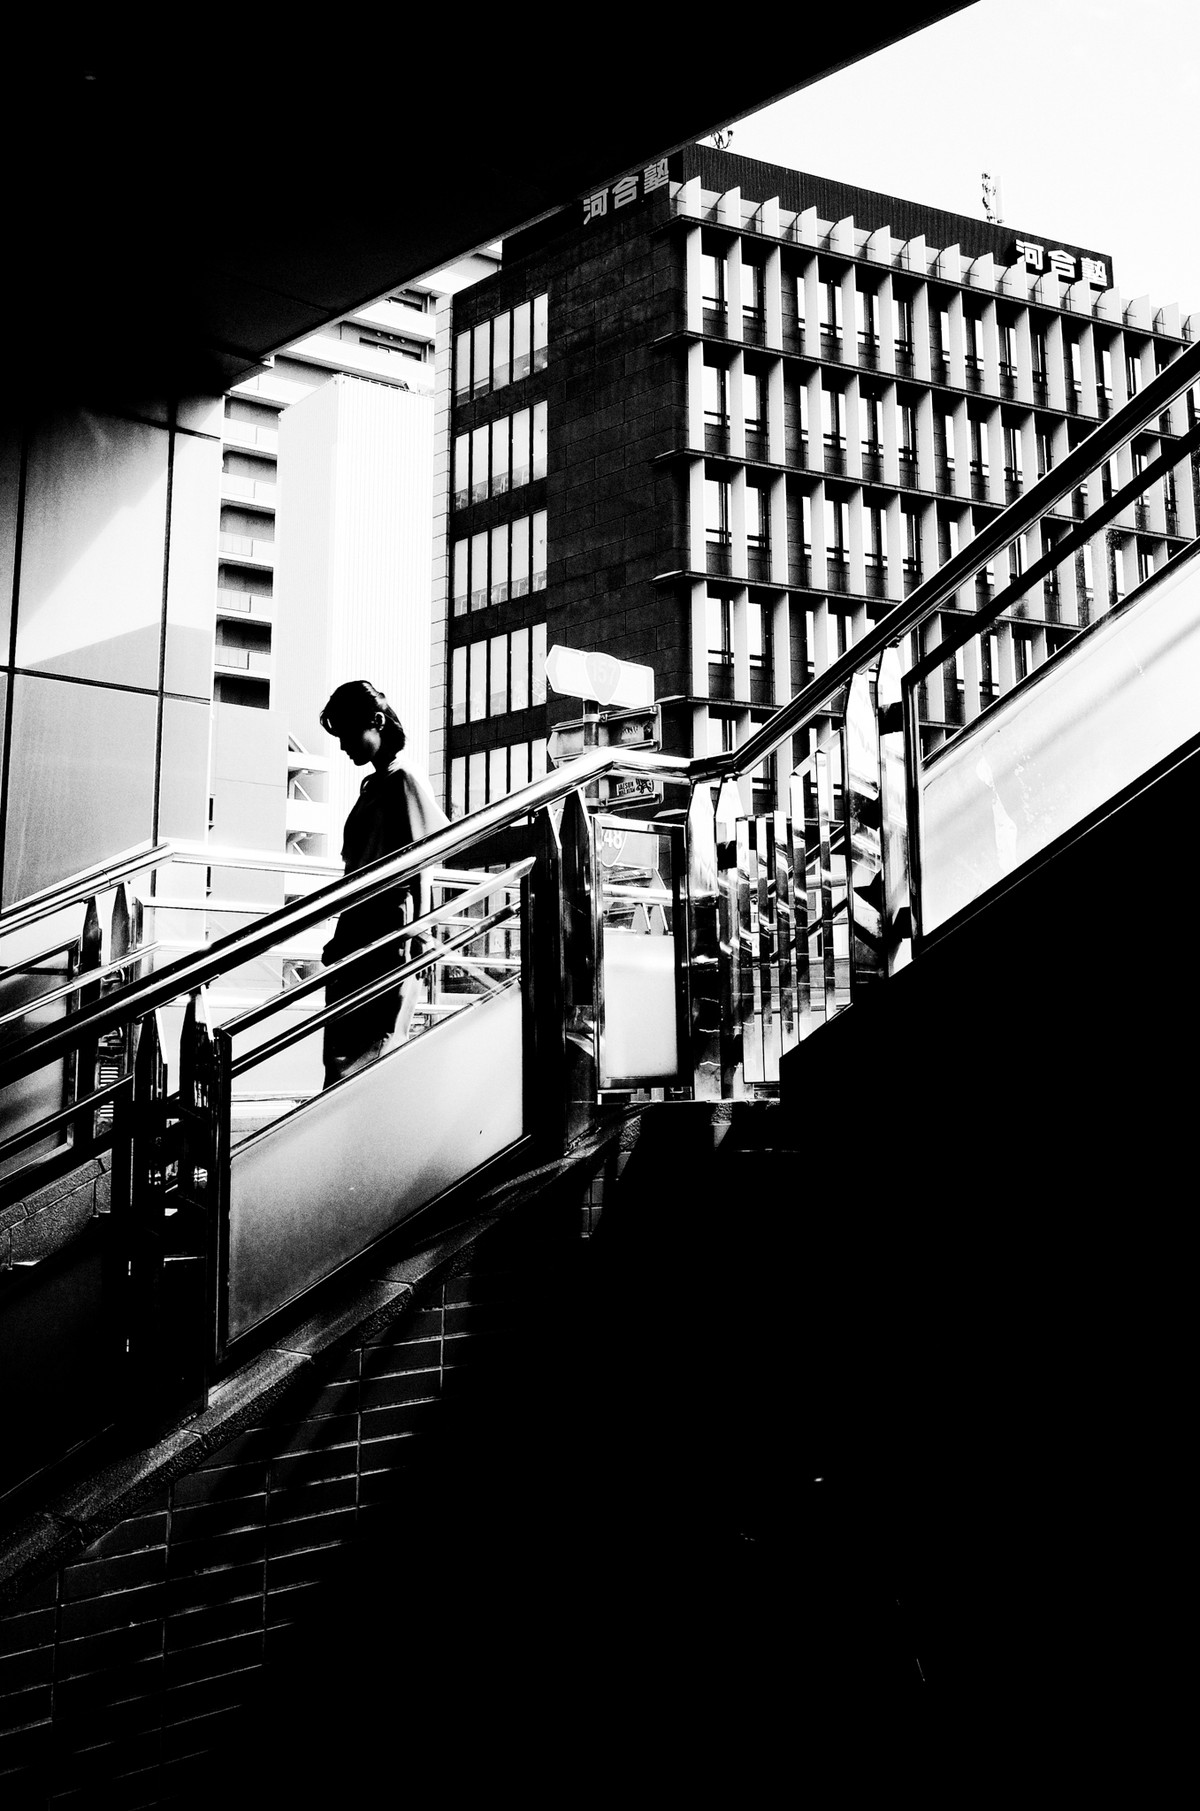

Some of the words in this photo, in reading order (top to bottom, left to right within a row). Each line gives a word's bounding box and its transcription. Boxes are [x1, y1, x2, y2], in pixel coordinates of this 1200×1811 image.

[584, 158, 669, 225] 河合塾
[1016, 239, 1107, 286] 河合塾
[602, 830, 623, 850] 48
